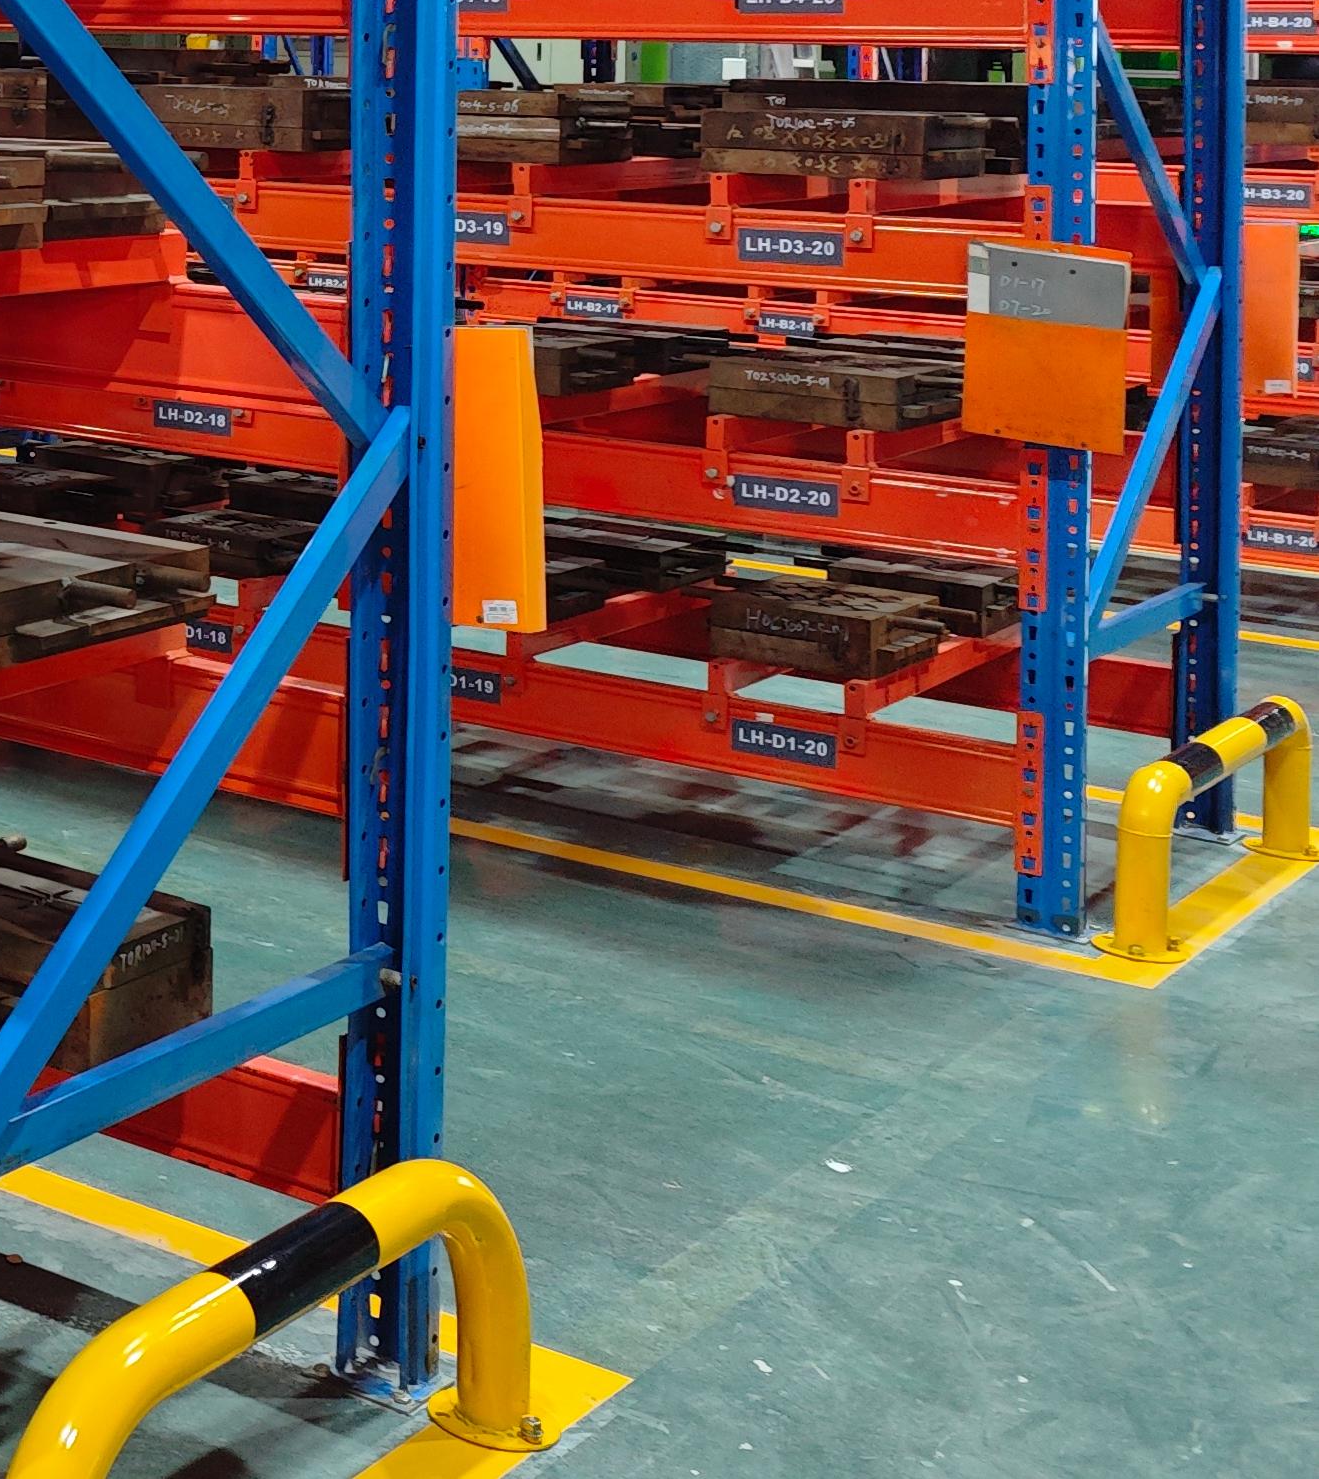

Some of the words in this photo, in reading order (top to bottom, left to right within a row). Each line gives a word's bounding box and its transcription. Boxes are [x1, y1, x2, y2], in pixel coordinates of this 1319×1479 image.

[746, 238, 835, 255] LH-D3-20
[158, 406, 226, 428] LH-D2-18
[741, 482, 831, 507] LH-D2-20
[738, 728, 829, 758] LH-D1-20
